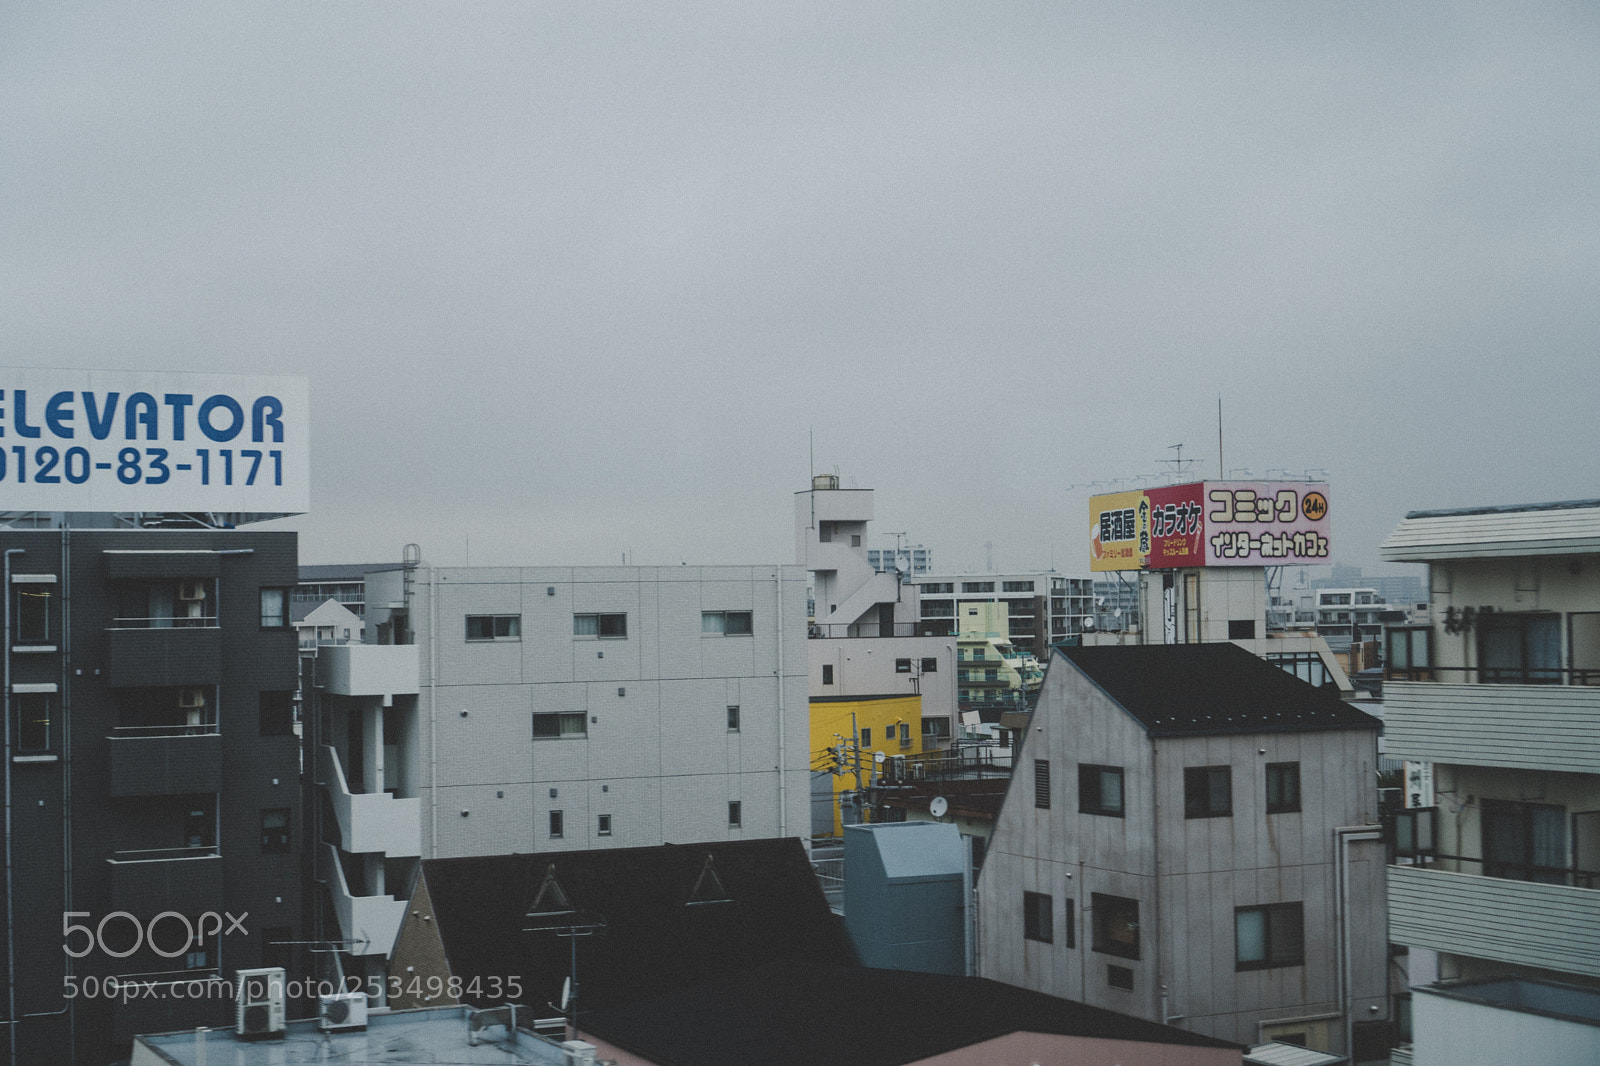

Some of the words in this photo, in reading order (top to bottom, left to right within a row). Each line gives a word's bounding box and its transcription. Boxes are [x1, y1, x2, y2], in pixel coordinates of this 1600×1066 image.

[0, 389, 285, 442] LEVATOR
[0, 445, 283, 486] 120-83-1171
[1152, 501, 1202, 537] カラオケ
[1209, 489, 1298, 523] コミック
[1304, 498, 1325, 514] 24H
[1099, 508, 1136, 544] 居酒屋
[1211, 531, 1329, 558] インターネットカフェ
